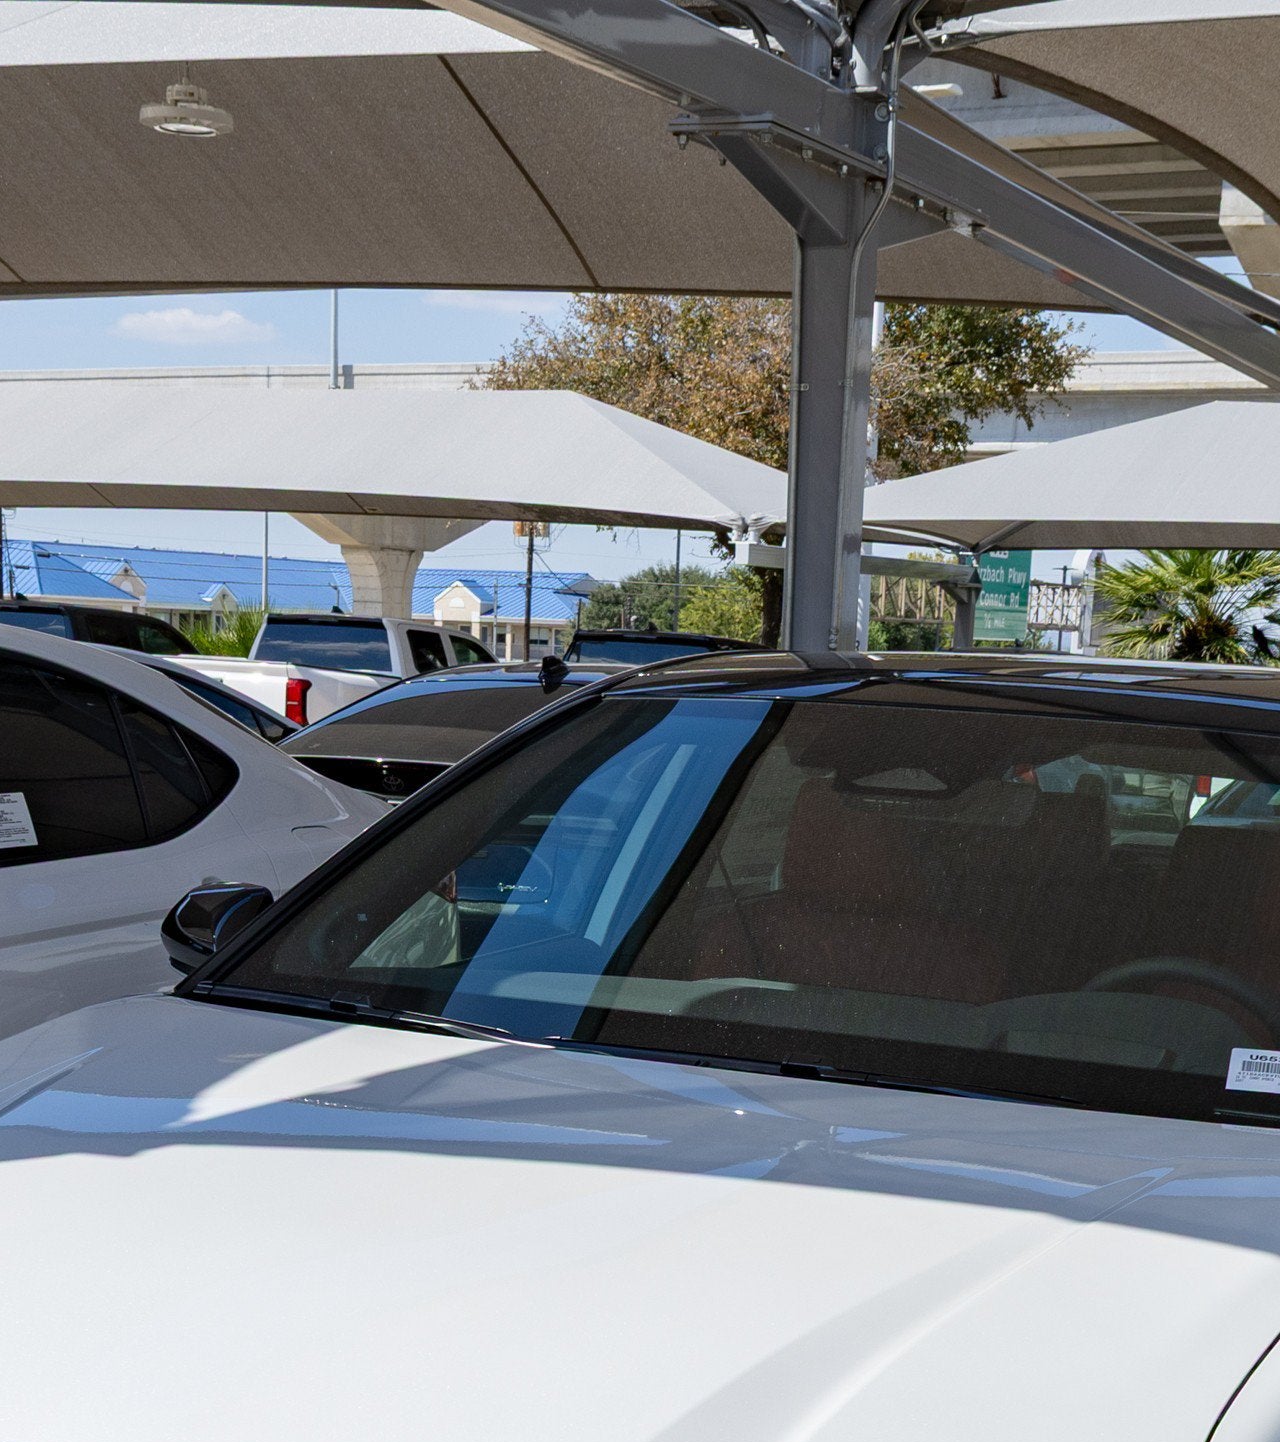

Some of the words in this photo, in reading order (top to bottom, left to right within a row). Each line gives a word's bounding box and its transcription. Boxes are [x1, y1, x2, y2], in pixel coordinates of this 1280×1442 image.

[979, 565, 1005, 583] rzbach
[1007, 567, 1028, 589] Pkwy
[1009, 591, 1020, 608] Rd
